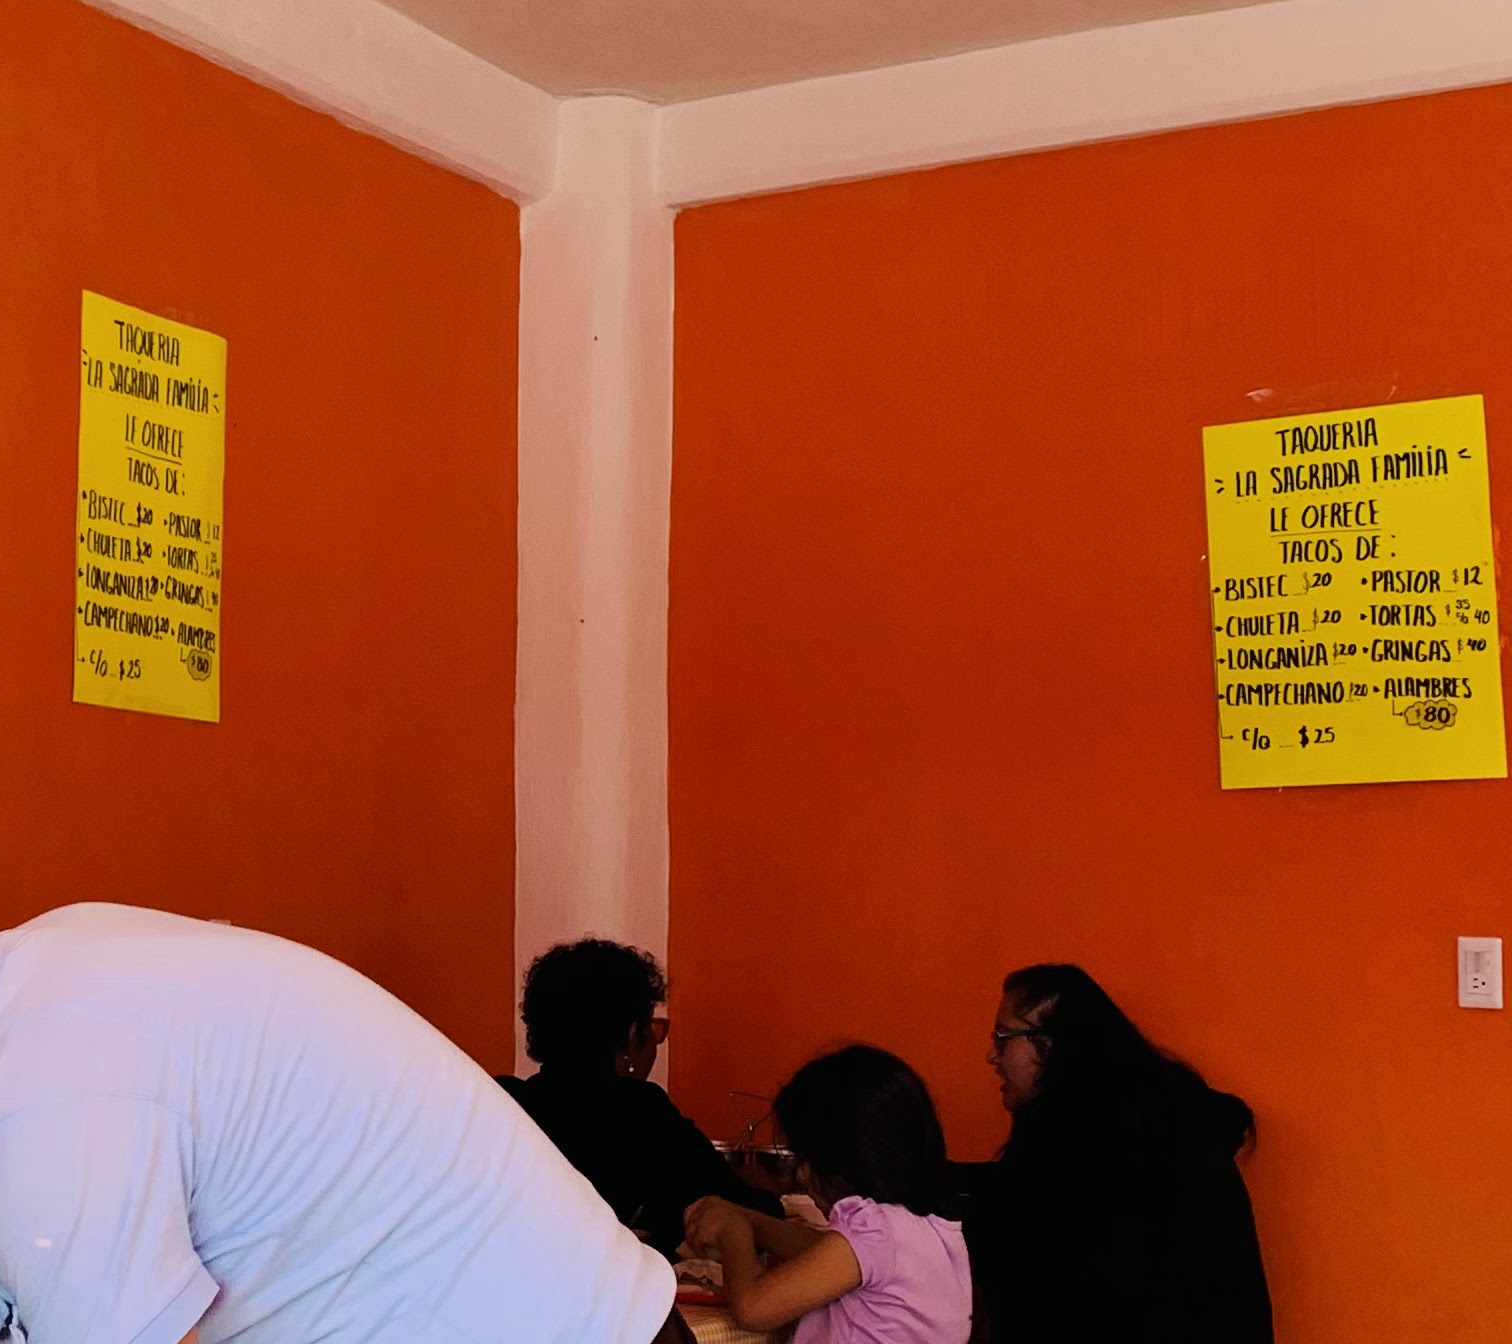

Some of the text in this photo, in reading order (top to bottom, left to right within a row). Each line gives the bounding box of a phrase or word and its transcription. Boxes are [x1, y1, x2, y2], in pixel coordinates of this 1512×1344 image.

[114, 320, 180, 366] TAQUERIA
[87, 356, 103, 389] LA
[109, 361, 160, 403] SAGRADA
[125, 413, 185, 458] LE OFRECE
[1275, 418, 1378, 456] TAQUERIA
[128, 457, 160, 490] TACOS
[1236, 470, 1257, 497] LA
[1270, 459, 1360, 494] SAGRADA
[89, 489, 125, 526] BISTEC
[1270, 499, 1379, 532] LE OFRECE
[168, 512, 202, 542] PASTOR
[87, 528, 131, 562] CHULETA
[167, 544, 200, 575] TORTAS
[1279, 538, 1343, 564] TACOS
[86, 563, 144, 601] LONGANIZA
[164, 575, 204, 609] GRINGAS
[1225, 574, 1288, 601] BISTEC
[1372, 570, 1440, 593] PASTOR
[84, 600, 153, 637] CAMPECHANO
[1226, 611, 1299, 638] CHULETA
[1369, 604, 1437, 627] TORTAS
[1371, 638, 1451, 662] GRINGAS
[1226, 681, 1344, 707] CAMPECHANO
[1384, 677, 1472, 699] ALAMBRES
